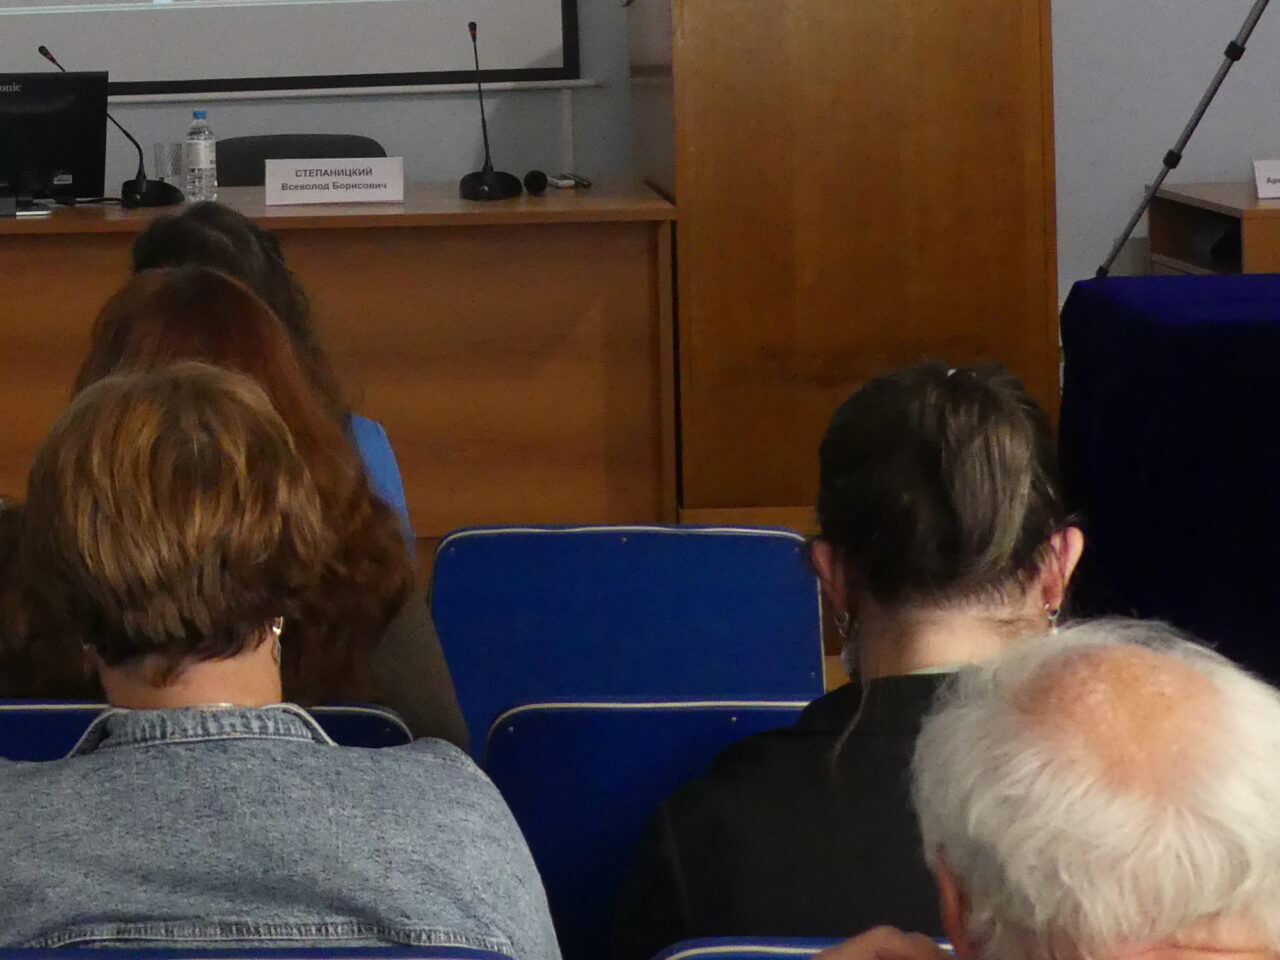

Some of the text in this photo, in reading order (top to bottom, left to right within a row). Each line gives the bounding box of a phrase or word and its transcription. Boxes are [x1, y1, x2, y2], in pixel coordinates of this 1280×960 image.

[294, 167, 373, 178] СТЕПАНИЦКИЙ
[281, 180, 387, 192] Всеволод Борисович
